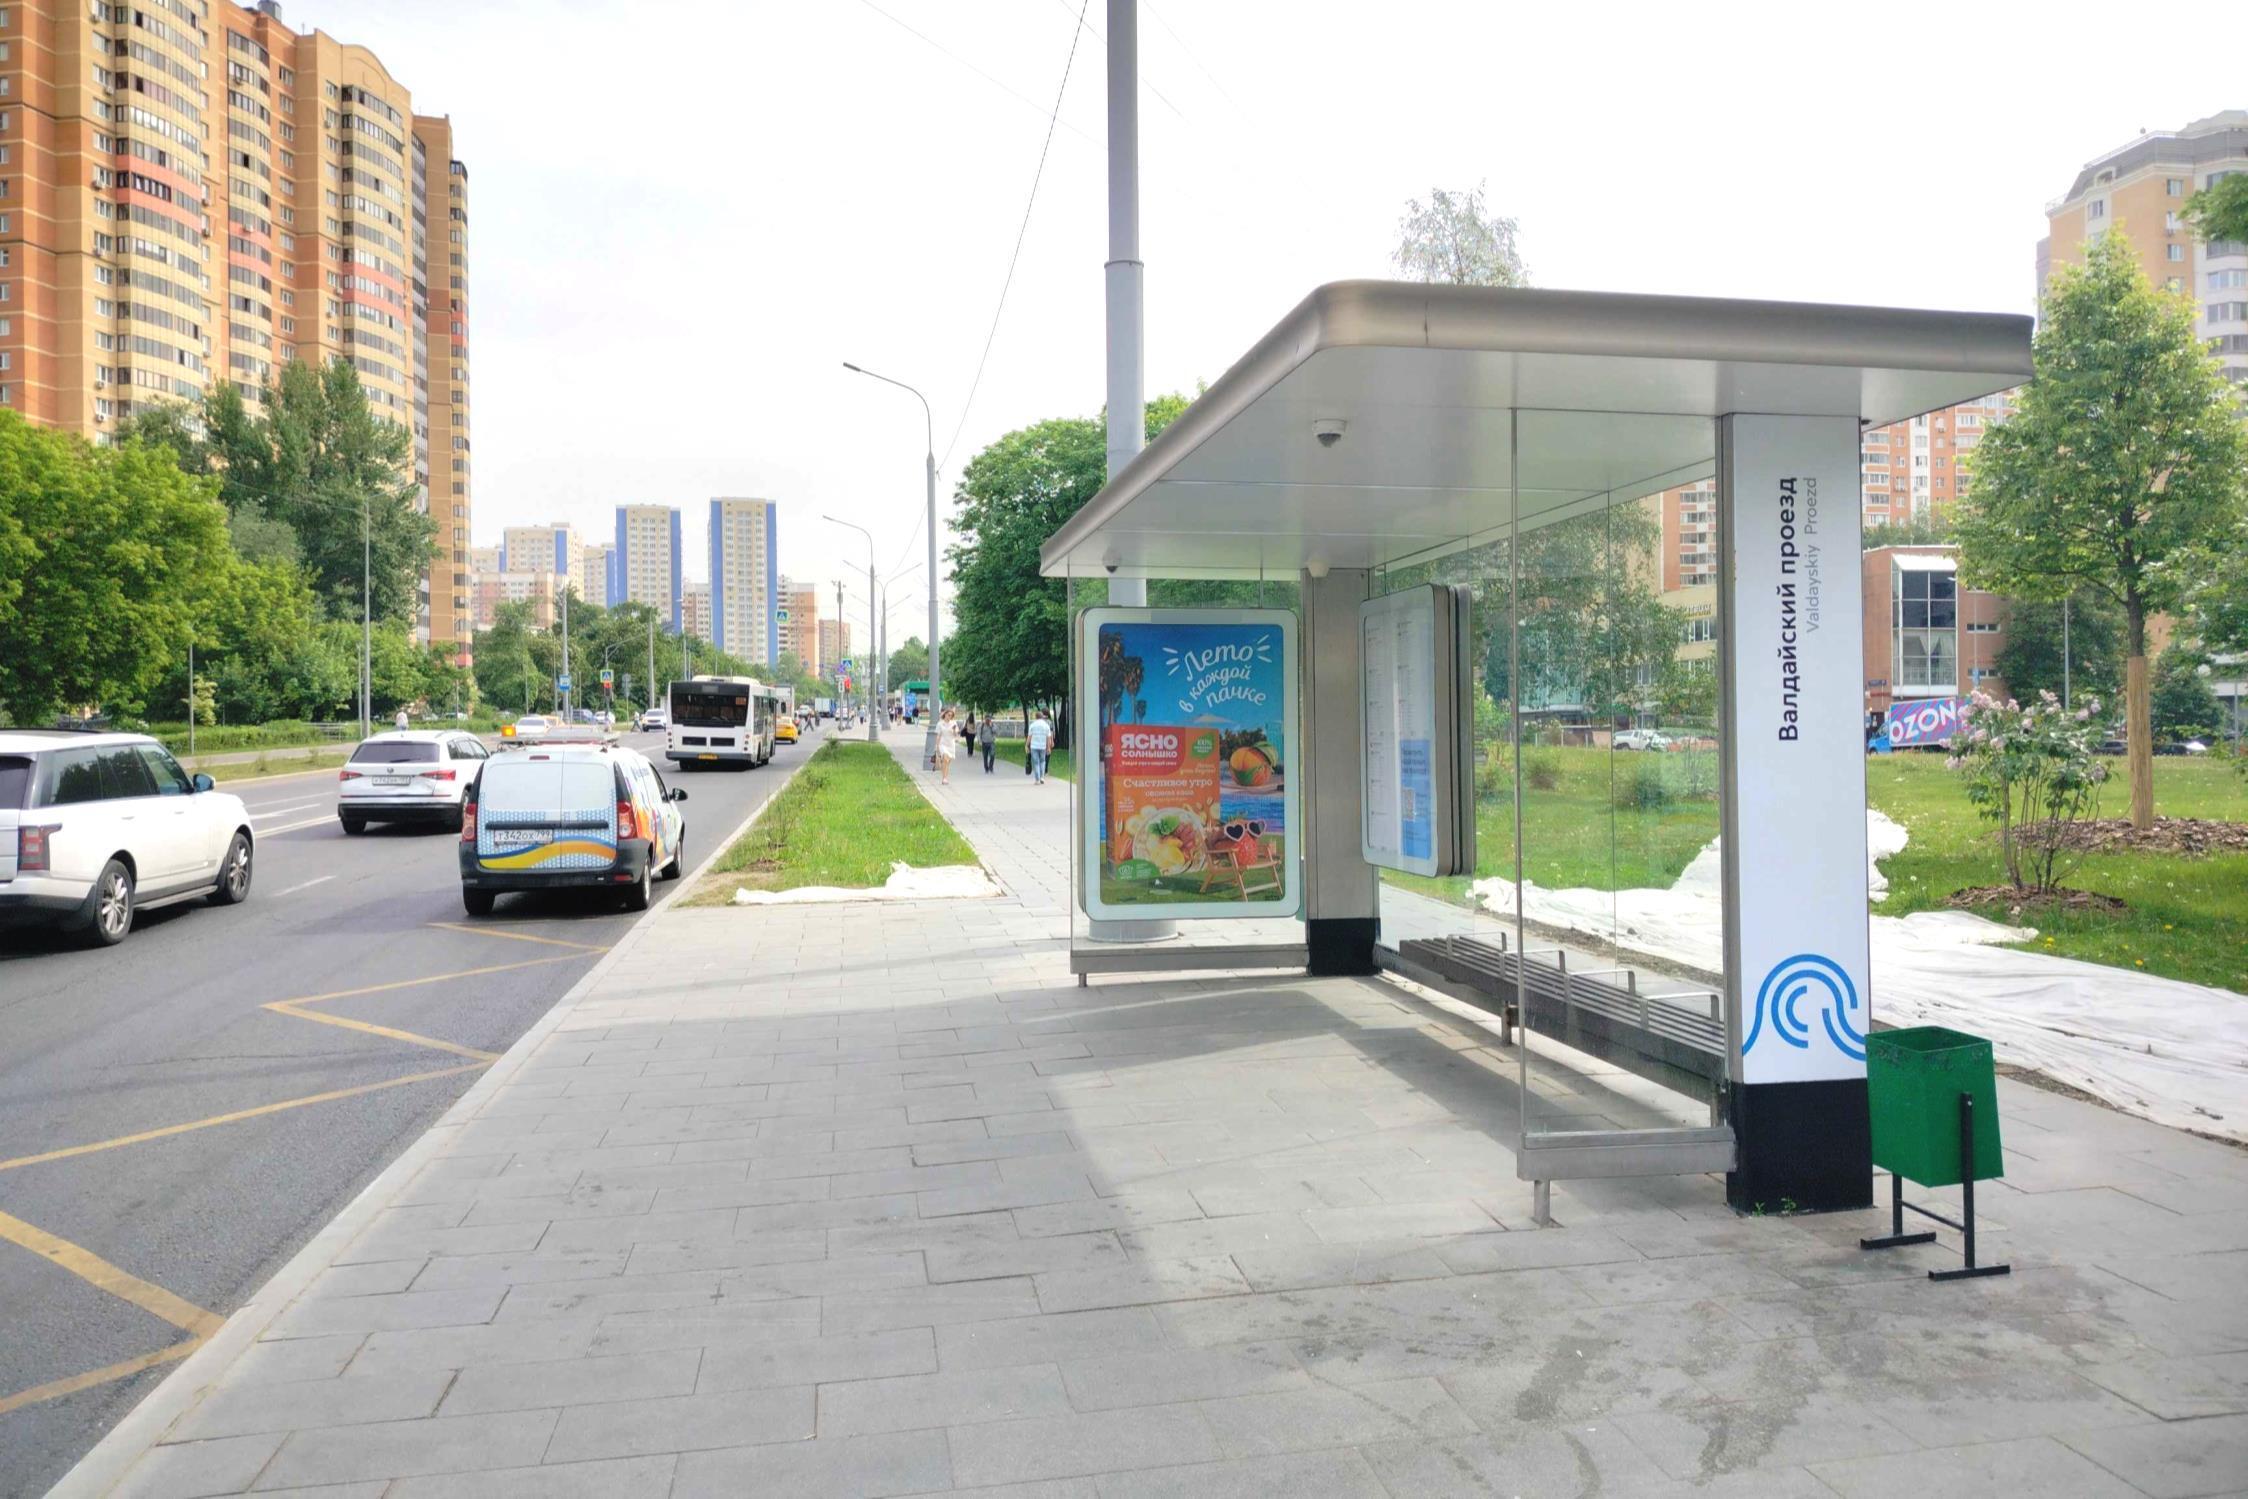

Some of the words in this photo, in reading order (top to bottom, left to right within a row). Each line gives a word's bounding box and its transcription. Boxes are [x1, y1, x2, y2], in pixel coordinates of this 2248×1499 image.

[1779, 477, 1800, 574] проезд
[1803, 476, 1818, 535] Proezd
[1803, 543, 1821, 634] Valdayskiy
[1184, 644, 1254, 682] Лето
[1777, 583, 1800, 741] Валдайский
[1178, 699, 1195, 713] в
[1189, 664, 1253, 701] каждой
[1120, 733, 1178, 750] ЯСНО
[1889, 700, 1956, 743] OZON
[1123, 778, 1187, 789] Счастливое
[1189, 778, 1213, 789] утро
